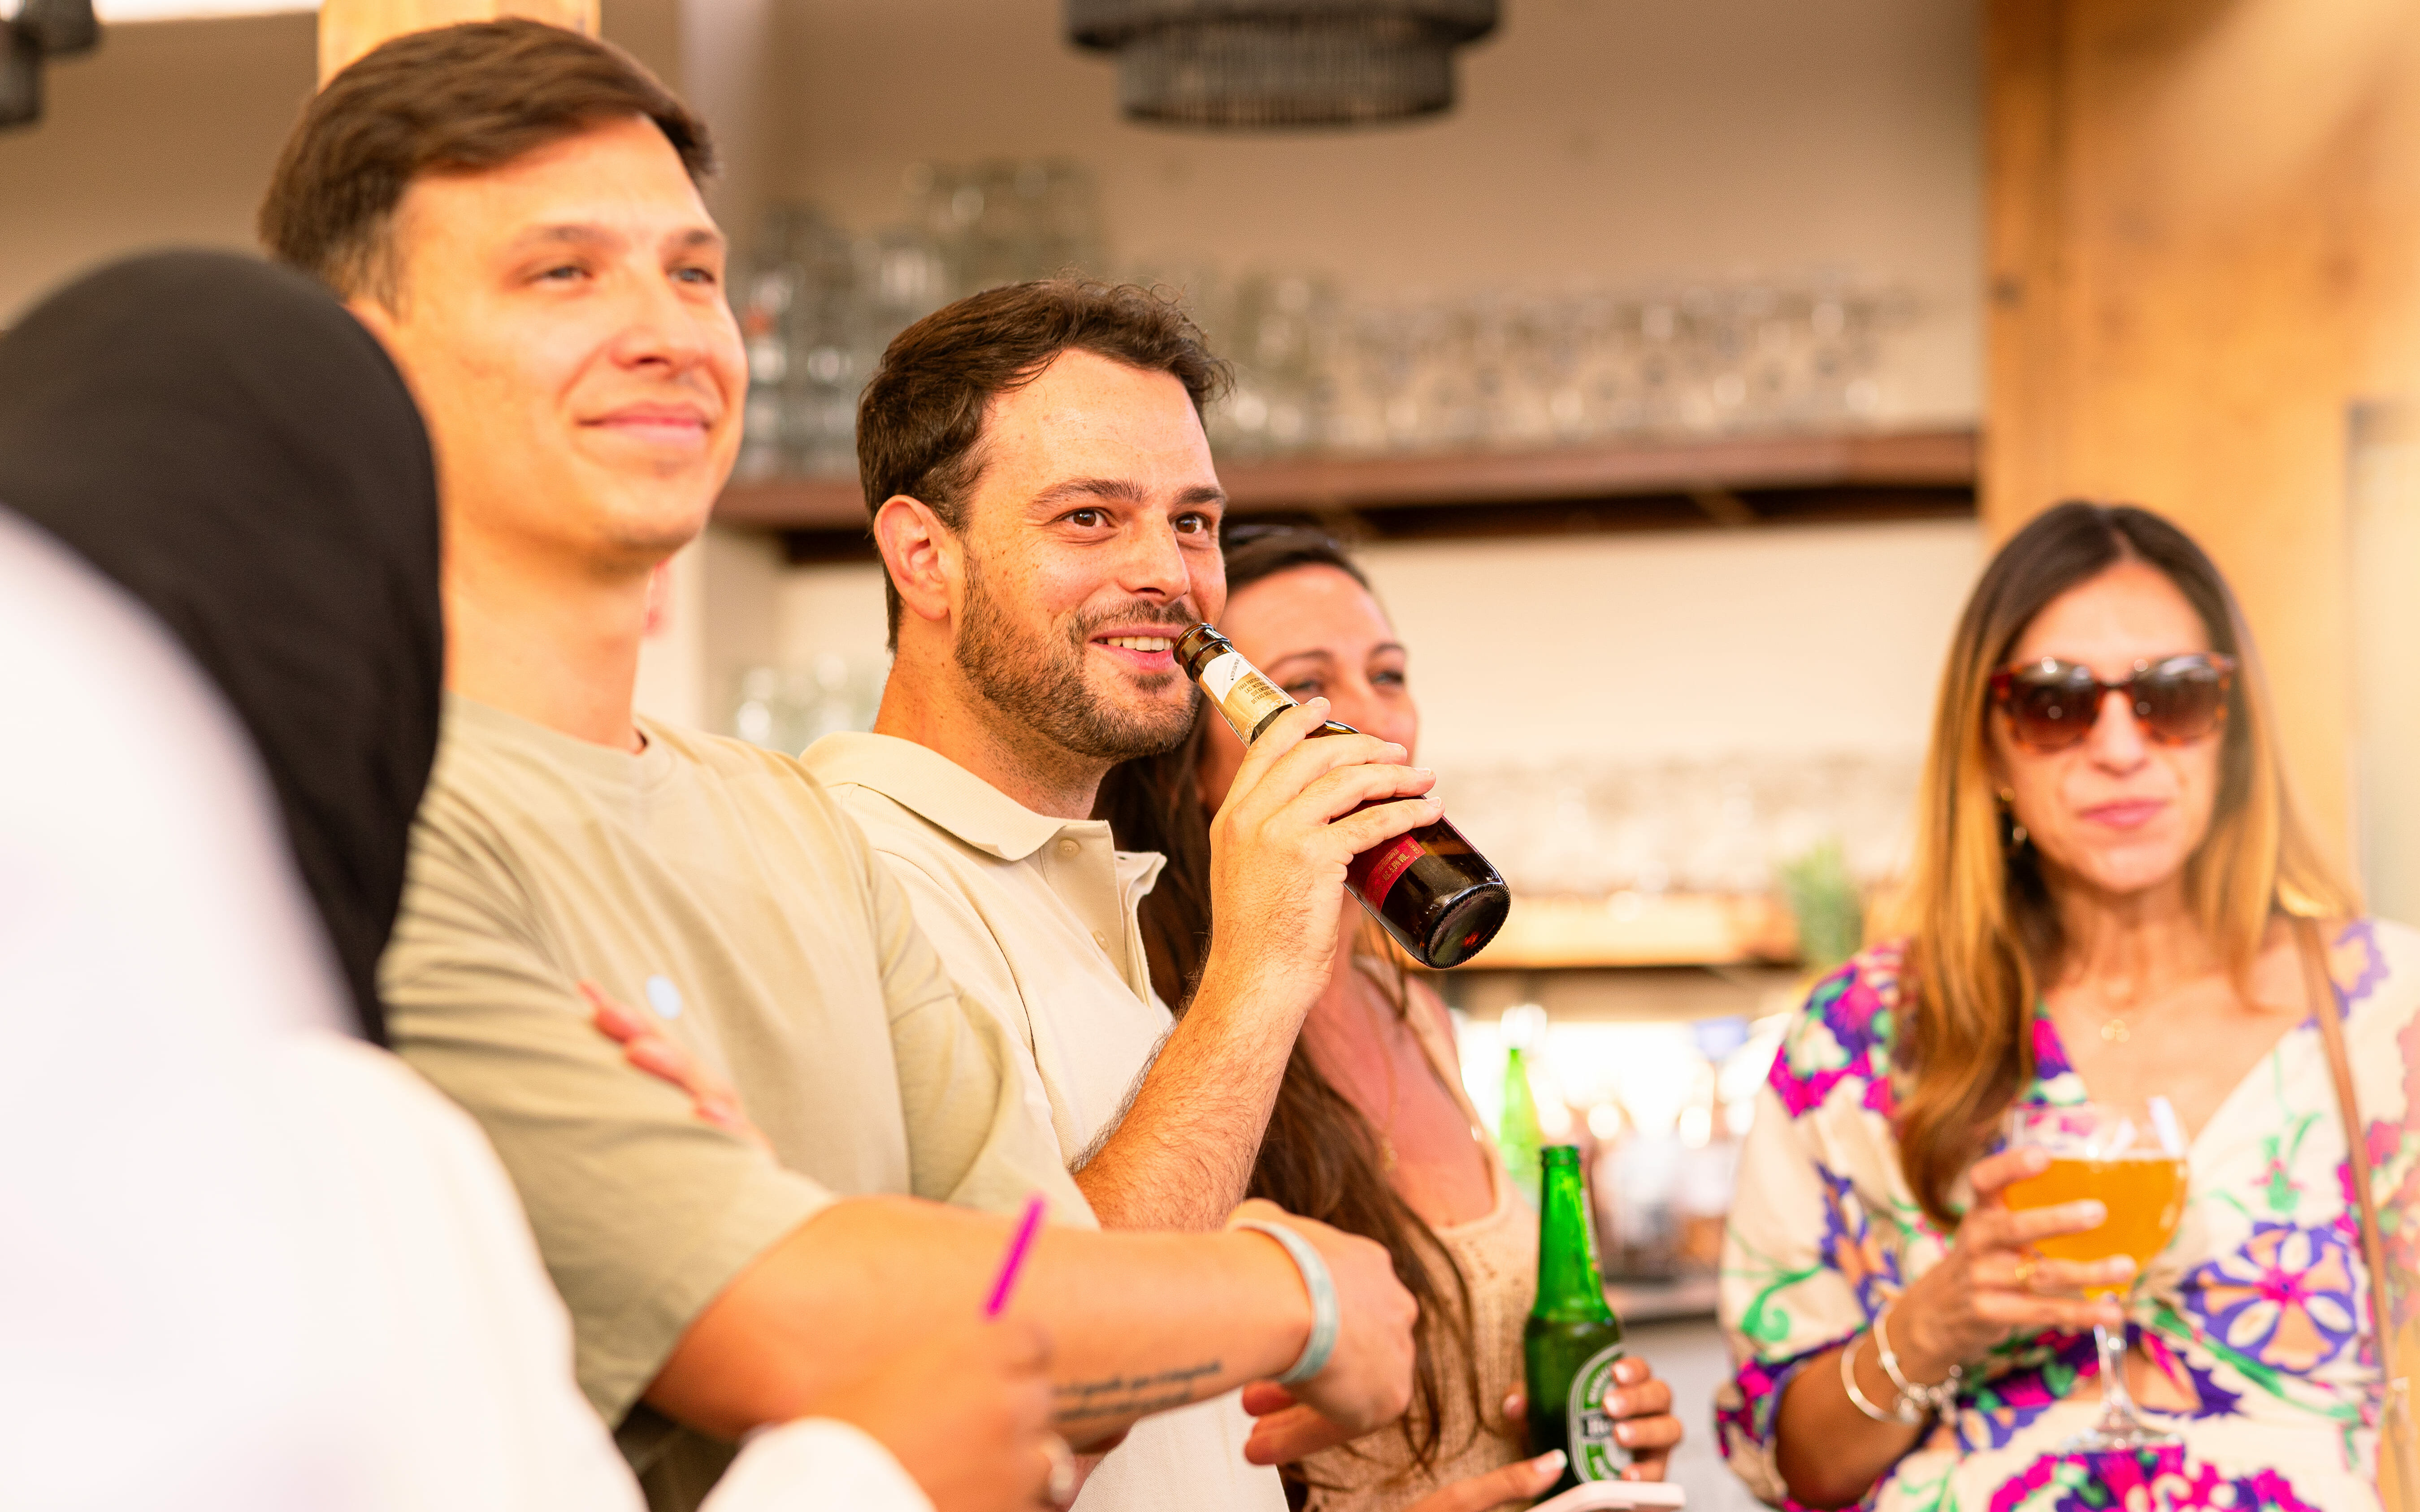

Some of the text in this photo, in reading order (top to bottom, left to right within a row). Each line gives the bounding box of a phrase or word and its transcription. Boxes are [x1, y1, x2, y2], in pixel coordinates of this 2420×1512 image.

[1251, 693, 1265, 704] DETRAS
[1382, 853, 1410, 882] ALC. 5,6% VOL.
